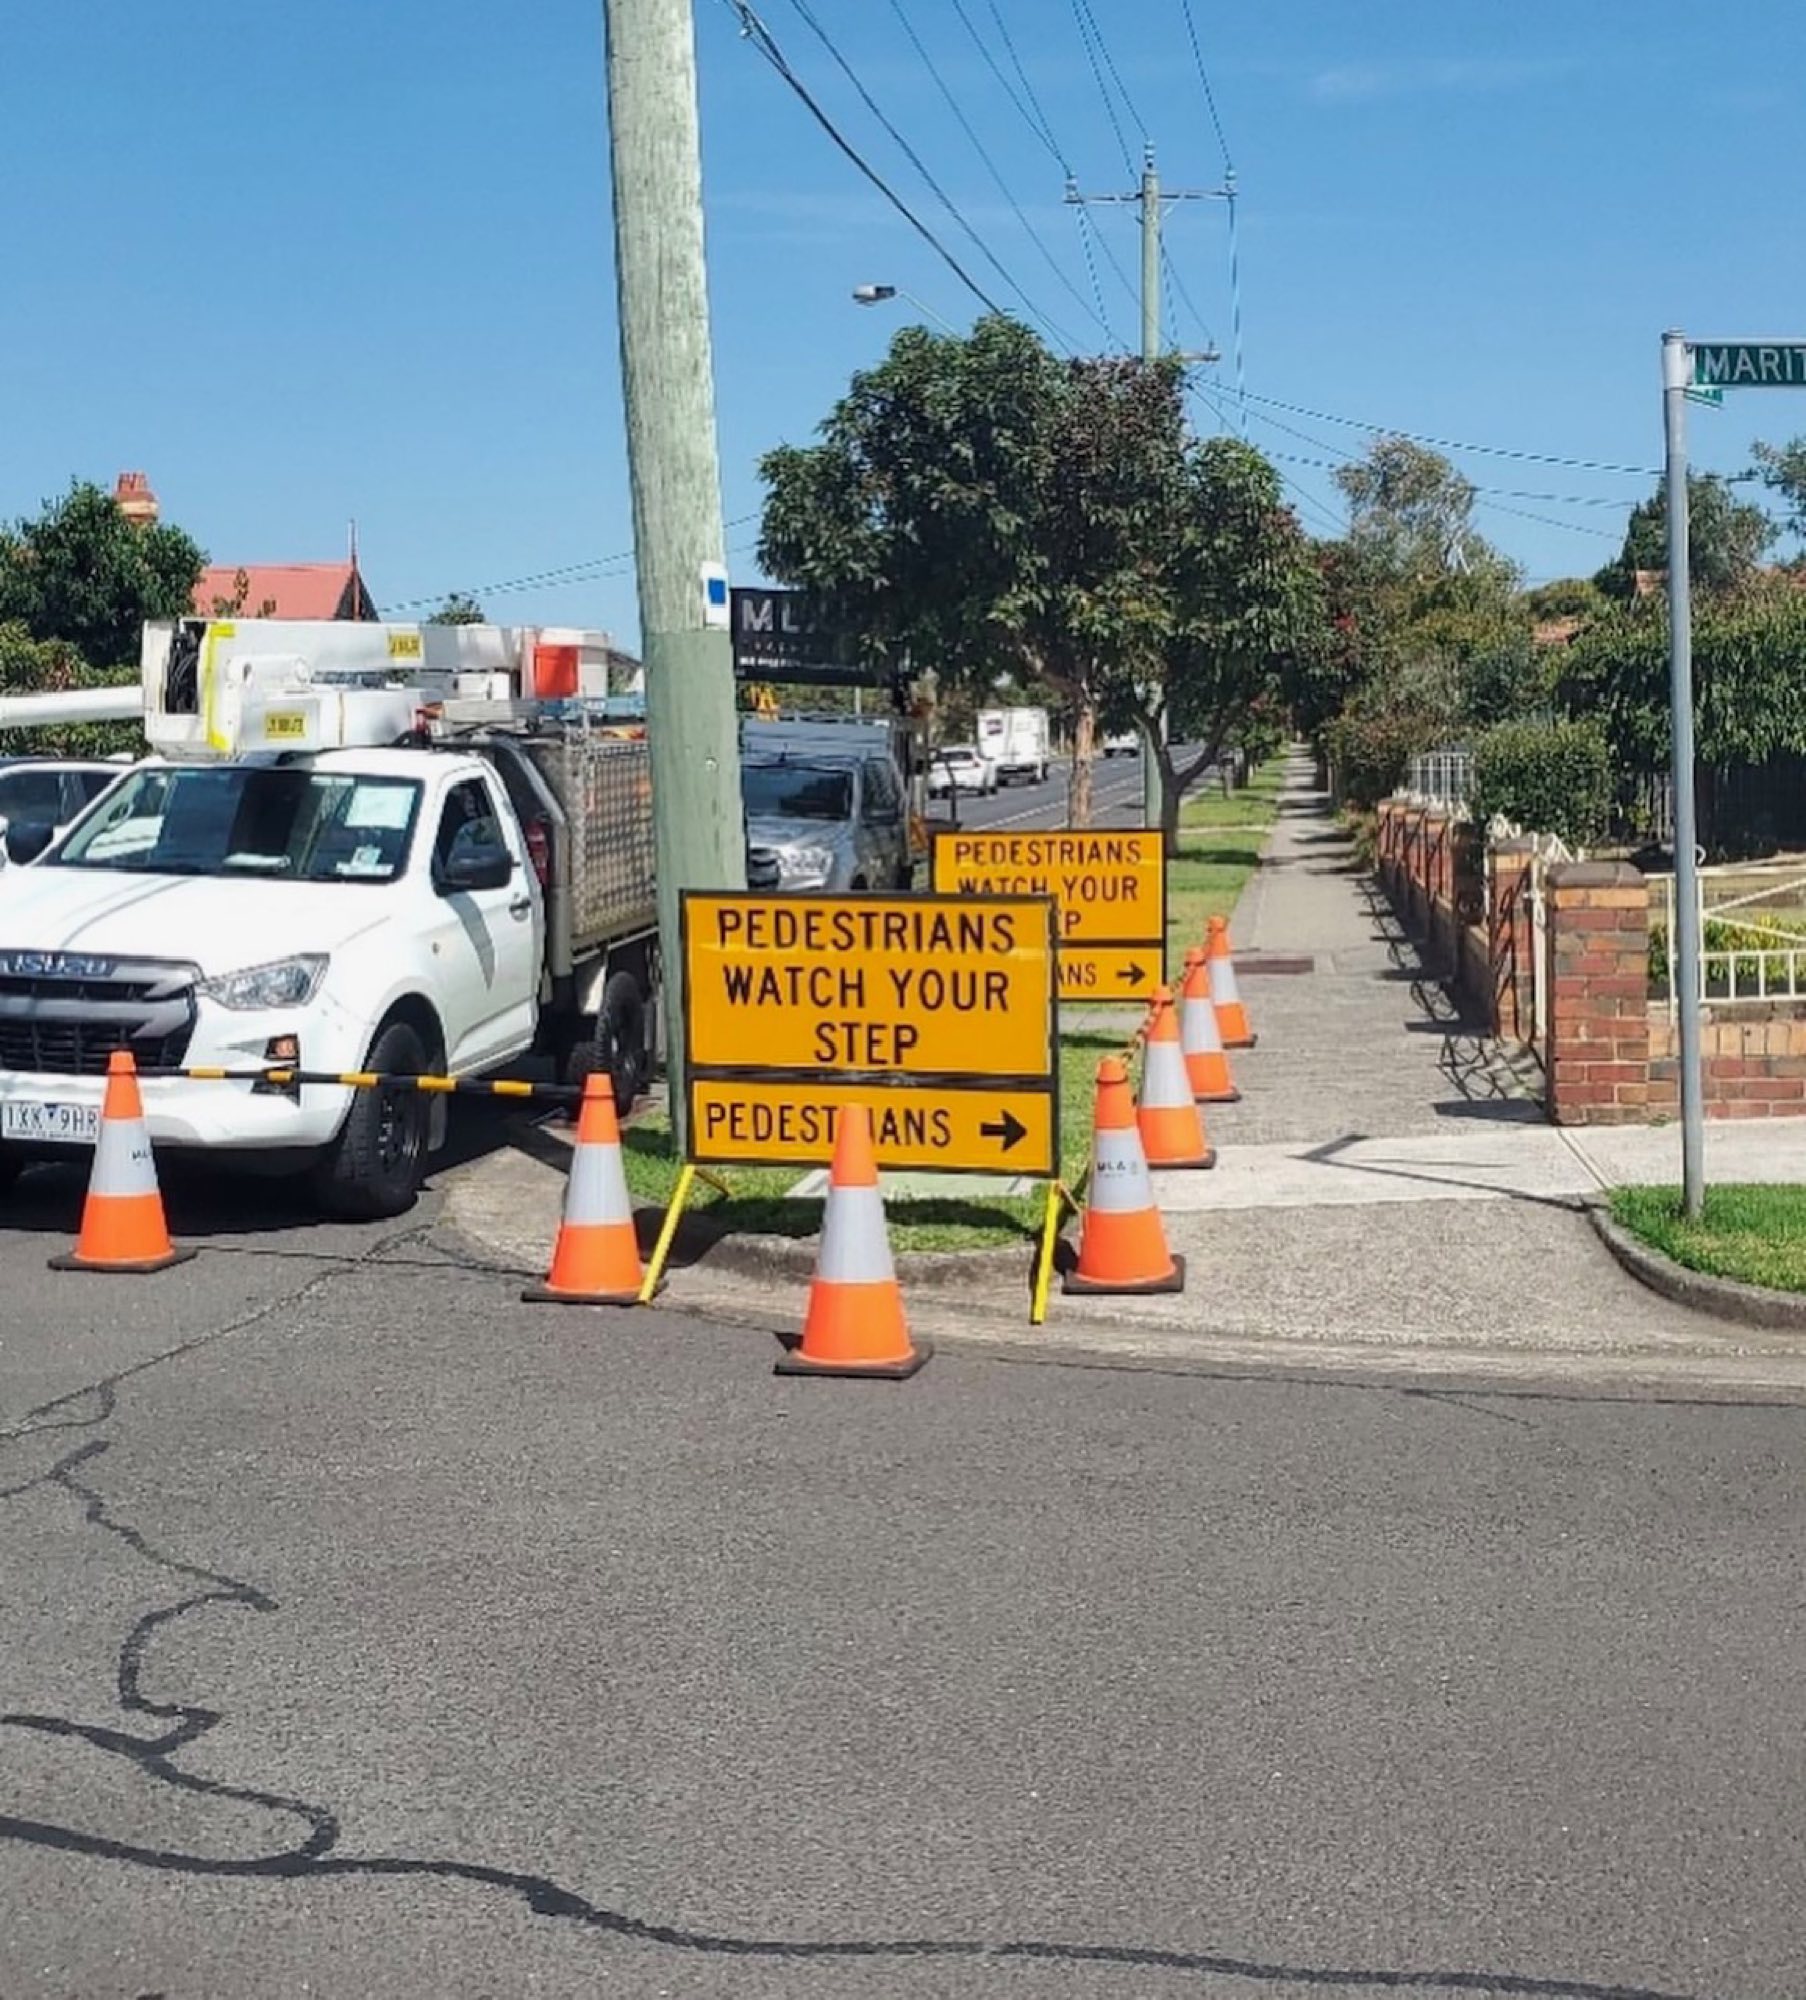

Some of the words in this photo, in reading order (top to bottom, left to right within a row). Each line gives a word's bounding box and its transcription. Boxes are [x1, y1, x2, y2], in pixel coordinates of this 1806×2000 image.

[742, 599, 815, 632] ML
[955, 839, 1142, 866] PEDESTRIANS
[1062, 875, 1139, 902] YOUR
[717, 908, 1016, 953] PEDESTRIANS
[723, 965, 866, 1009] WATCH
[888, 968, 1011, 1012] YOUR
[814, 1022, 919, 1066] STEP
[706, 1102, 951, 1148] PEDESTIANS
